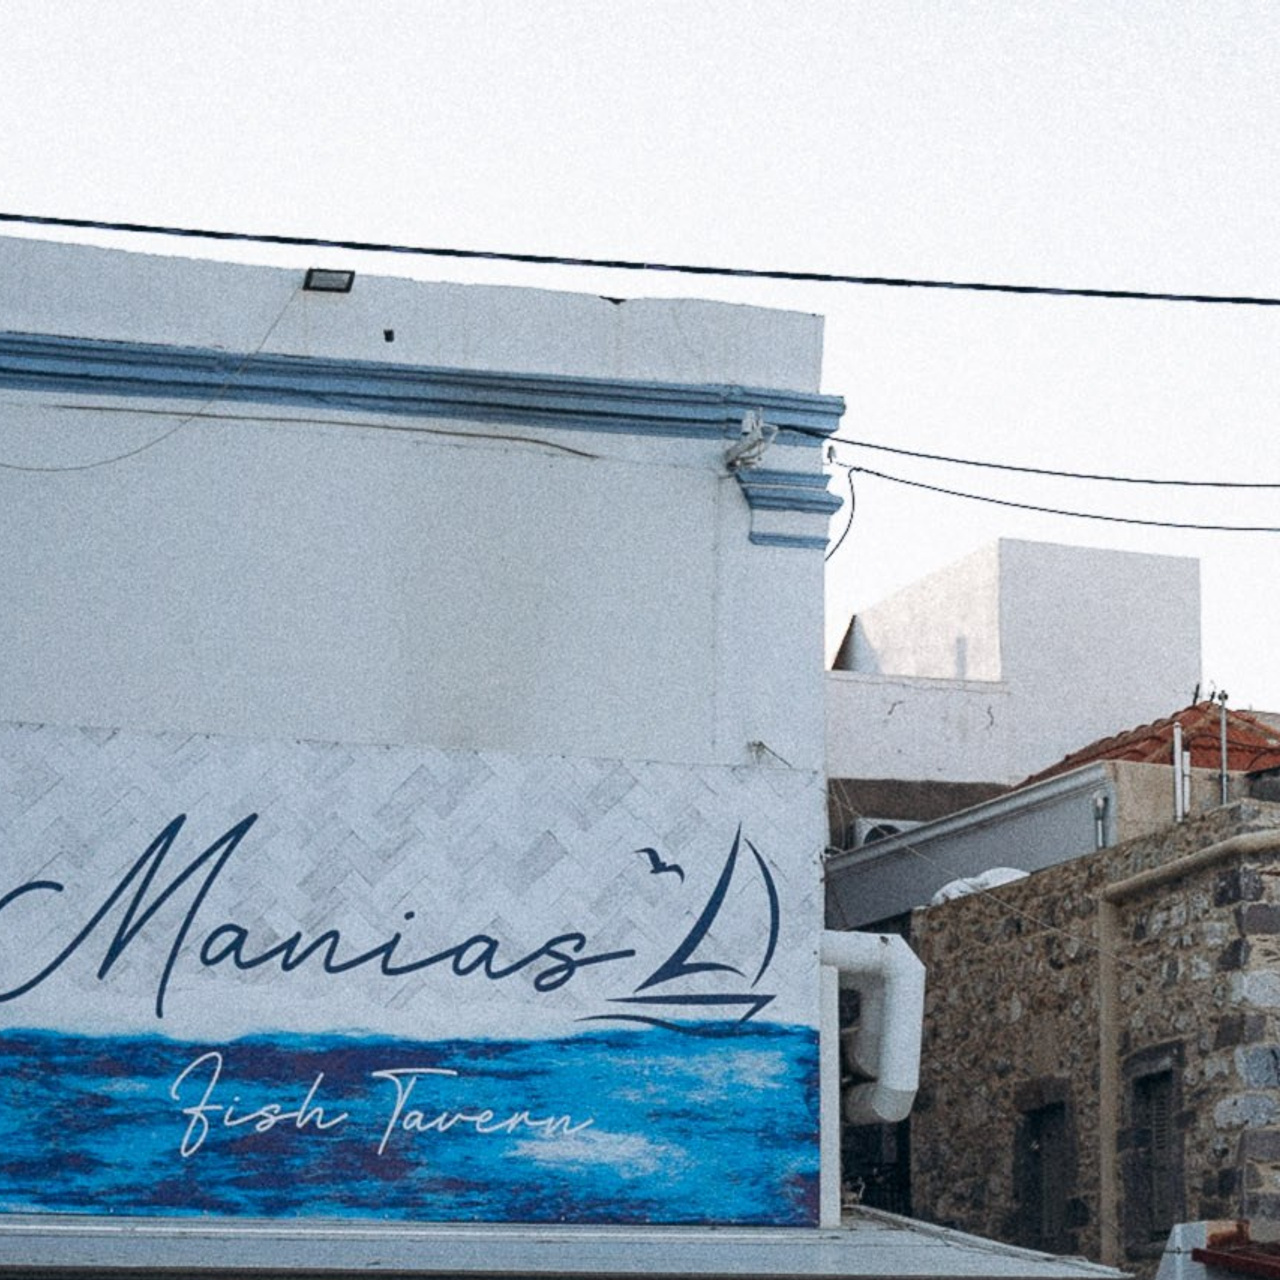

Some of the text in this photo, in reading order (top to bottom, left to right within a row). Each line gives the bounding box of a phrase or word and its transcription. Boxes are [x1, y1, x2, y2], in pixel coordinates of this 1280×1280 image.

[0, 813, 636, 1018] Manias
[170, 1052, 595, 1157] Fish Tavern
